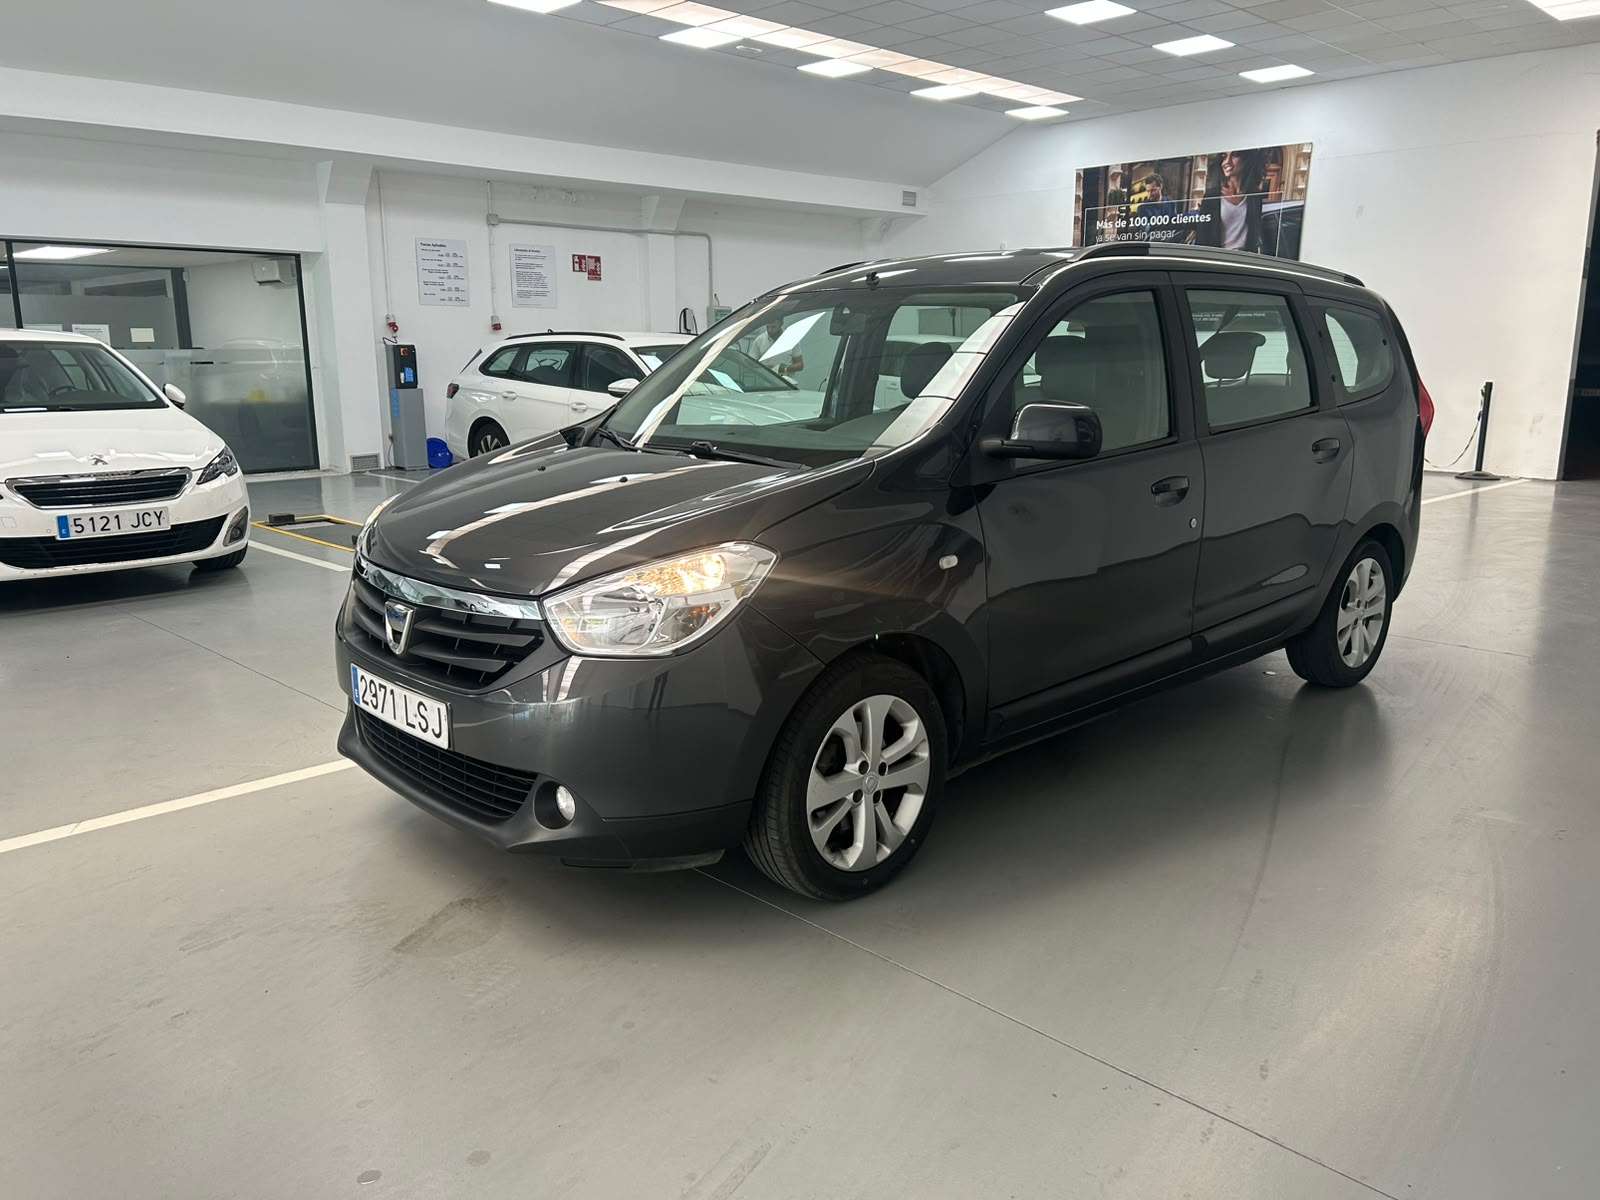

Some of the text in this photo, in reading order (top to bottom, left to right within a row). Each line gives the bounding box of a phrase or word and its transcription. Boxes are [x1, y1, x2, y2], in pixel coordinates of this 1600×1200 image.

[1115, 218, 1127, 228] de
[1129, 215, 1170, 227] 100.000
[1171, 213, 1211, 224] clientes
[1105, 232, 1115, 242] se
[1117, 231, 1132, 241] van
[1135, 229, 1148, 240] sin
[1150, 229, 1176, 241] pagar
[73, 514, 121, 534] 5121
[130, 510, 163, 529] JCY
[360, 674, 443, 739] 2971 LSJ
